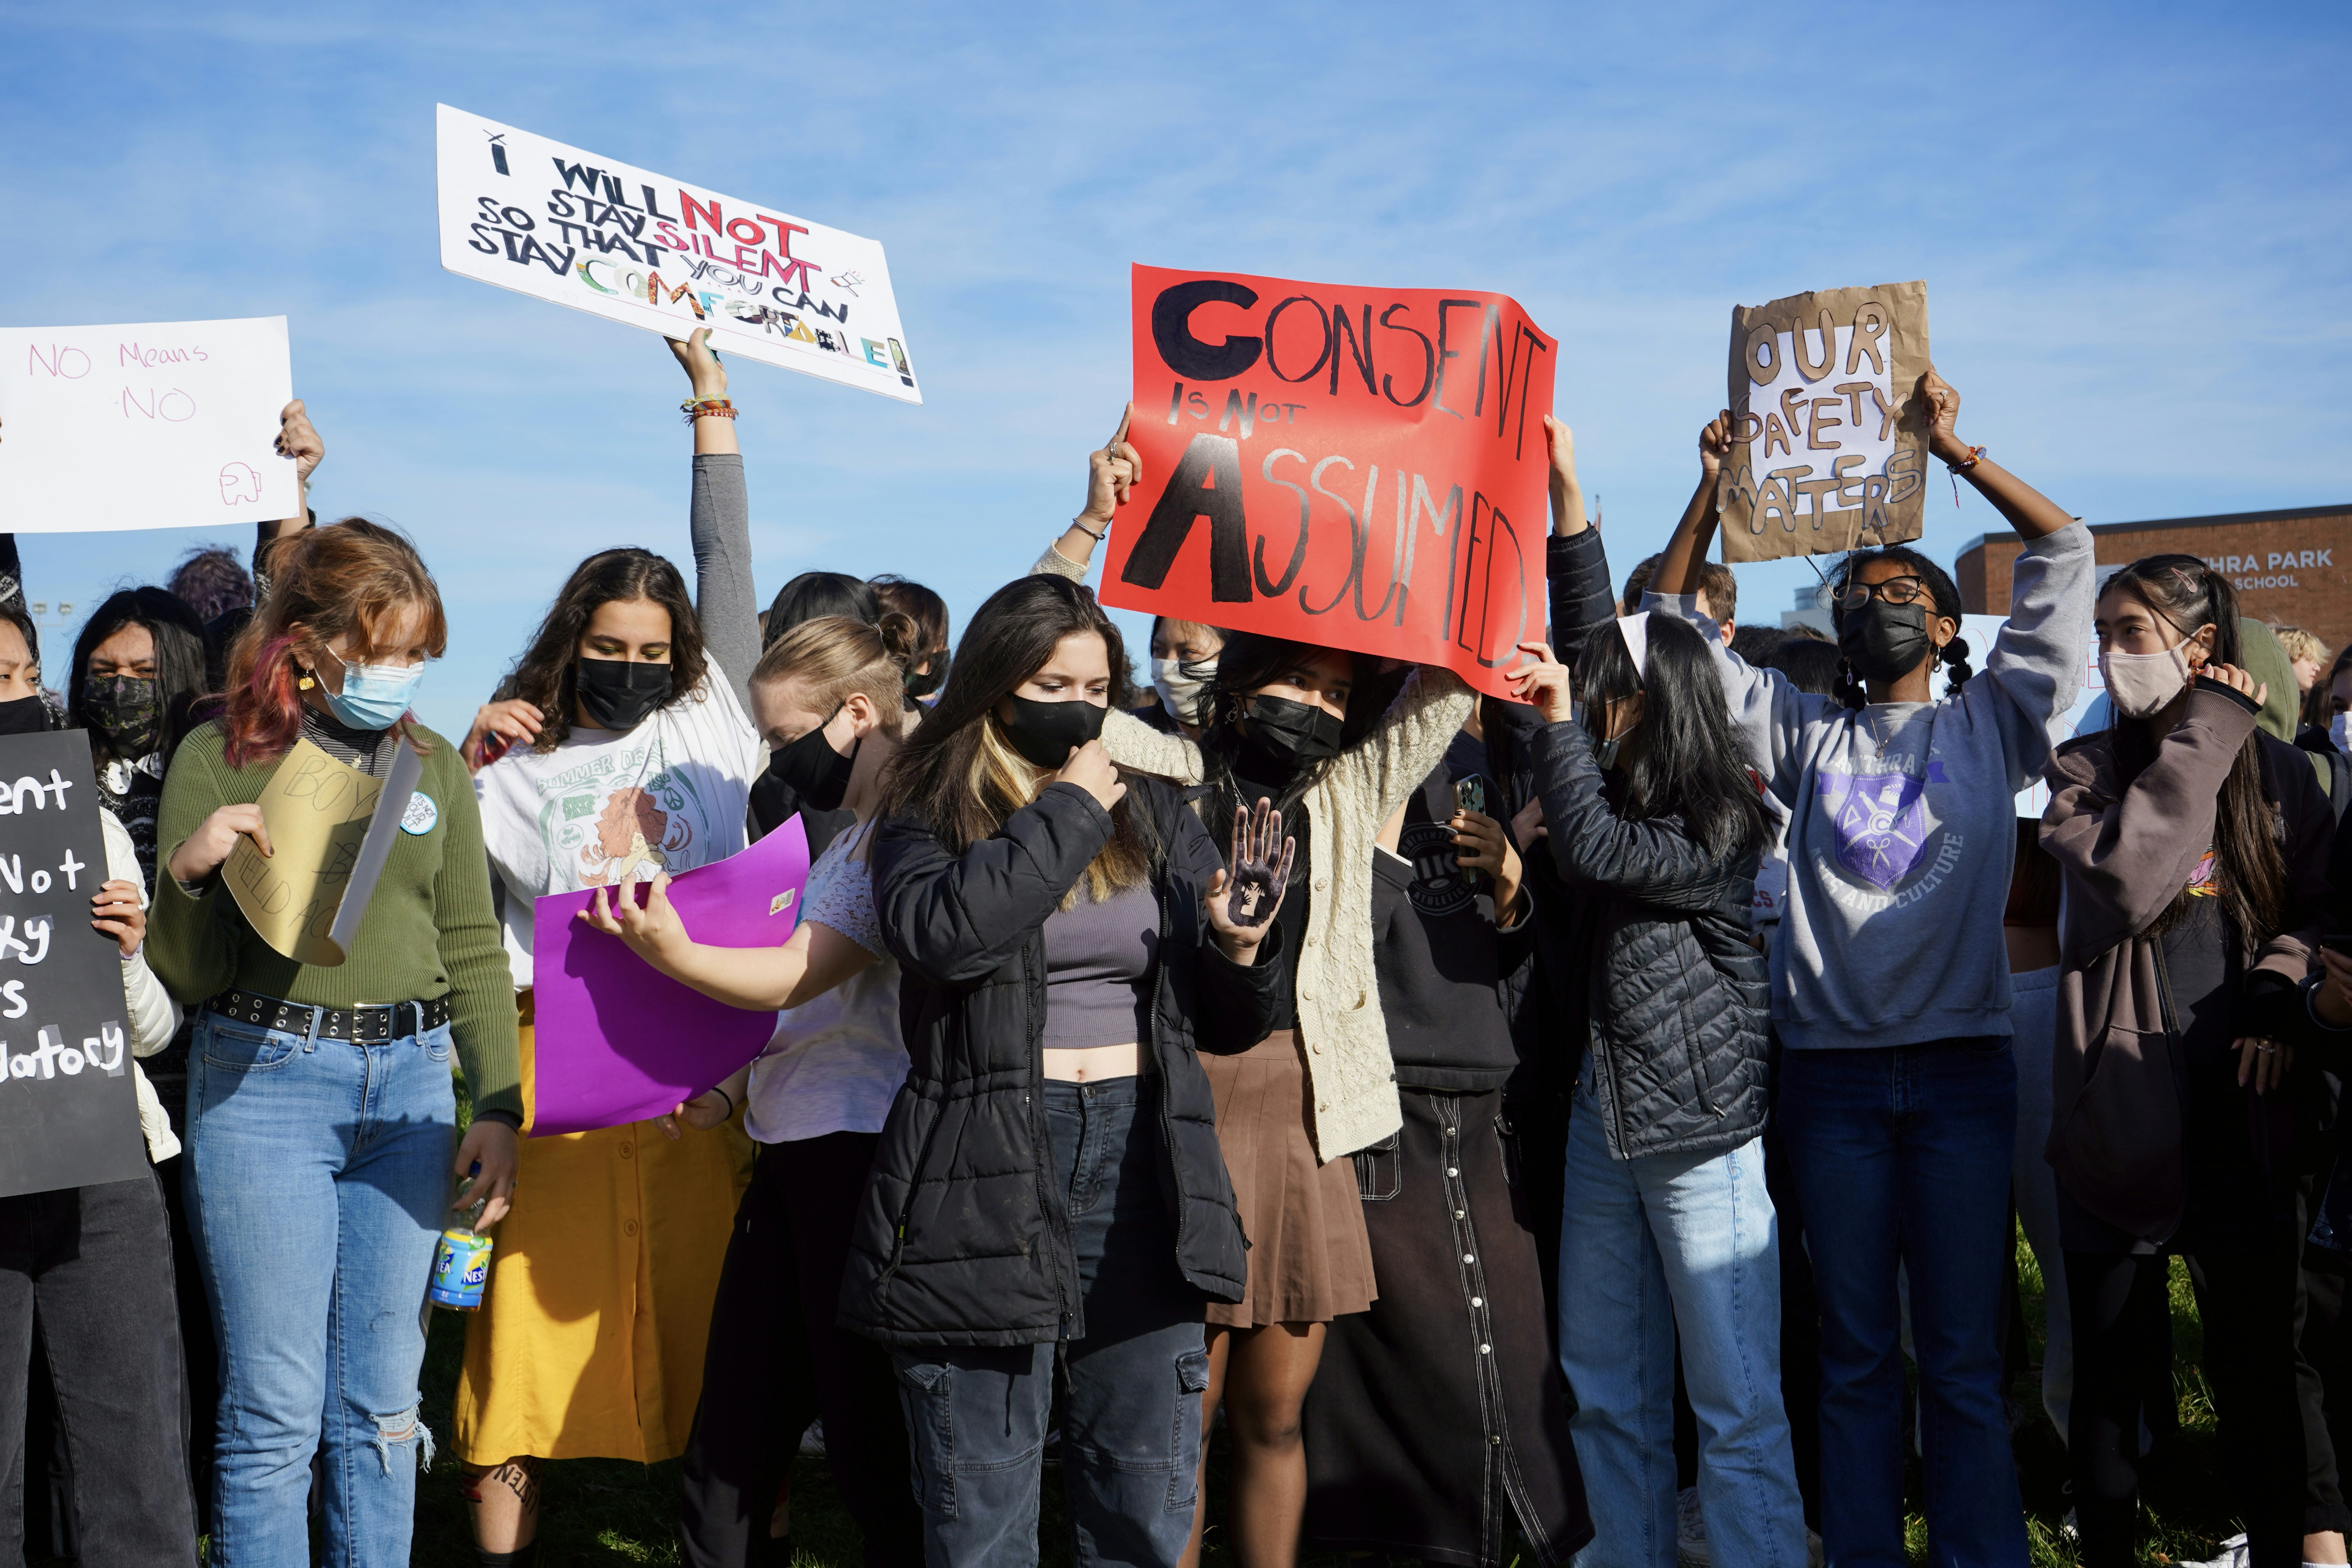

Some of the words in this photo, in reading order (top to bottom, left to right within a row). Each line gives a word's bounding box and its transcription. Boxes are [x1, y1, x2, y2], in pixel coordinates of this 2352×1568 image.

[469, 223, 575, 276] STAY
[548, 189, 646, 239] STAY
[653, 221, 822, 293] SILENT
[679, 189, 809, 258] NOT
[478, 197, 535, 230] SO
[548, 217, 668, 268] THAT
[680, 255, 762, 295] YOU
[772, 287, 848, 324] CAN
[29, 343, 91, 379] NO
[120, 342, 208, 368] Means
[1746, 302, 1888, 386] OUR
[123, 386, 196, 421] NO
[1733, 381, 1908, 458] SAFETY
[1716, 450, 1921, 534] MATTERS
[1120, 432, 1526, 668] ASSUMED
[2201, 554, 2259, 573] HRA
[2268, 549, 2333, 570] PARK
[2234, 574, 2298, 590] SCHOOL
[536, 754, 615, 796] SUMMER
[621, 747, 644, 770] OF
[1401, 831, 1449, 853] AUTHENTI
[1841, 891, 1889, 912] AND
[1894, 832, 1964, 909] CULTURE
